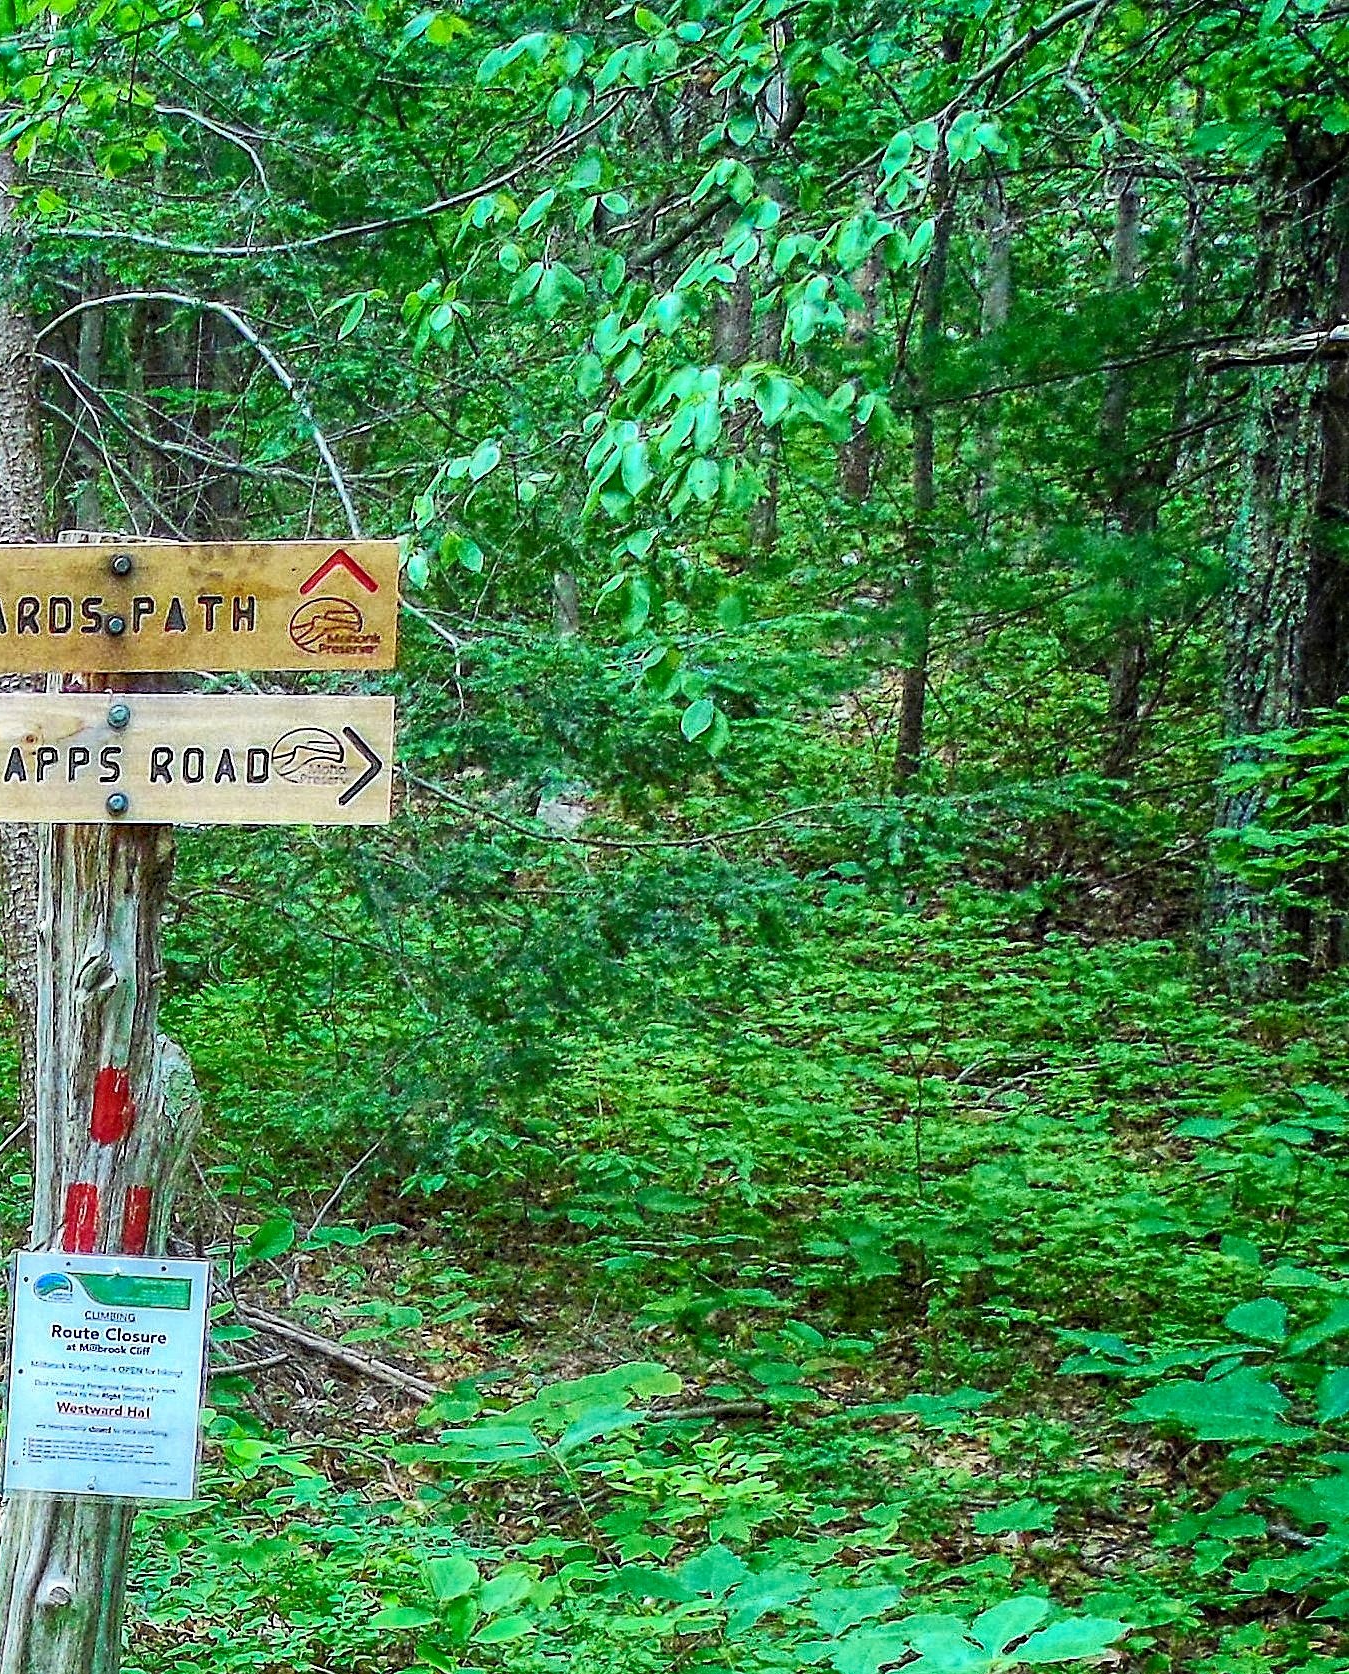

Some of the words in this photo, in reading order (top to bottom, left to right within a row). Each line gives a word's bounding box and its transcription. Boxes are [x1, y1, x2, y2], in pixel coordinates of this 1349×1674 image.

[132, 595, 256, 634] PATH
[150, 746, 270, 784] ROAD
[51, 1324, 100, 1341] Route
[105, 1327, 167, 1345] Closure
[66, 1344, 76, 1352] at
[129, 1346, 151, 1356] Cliff
[56, 1401, 123, 1418] Westward
